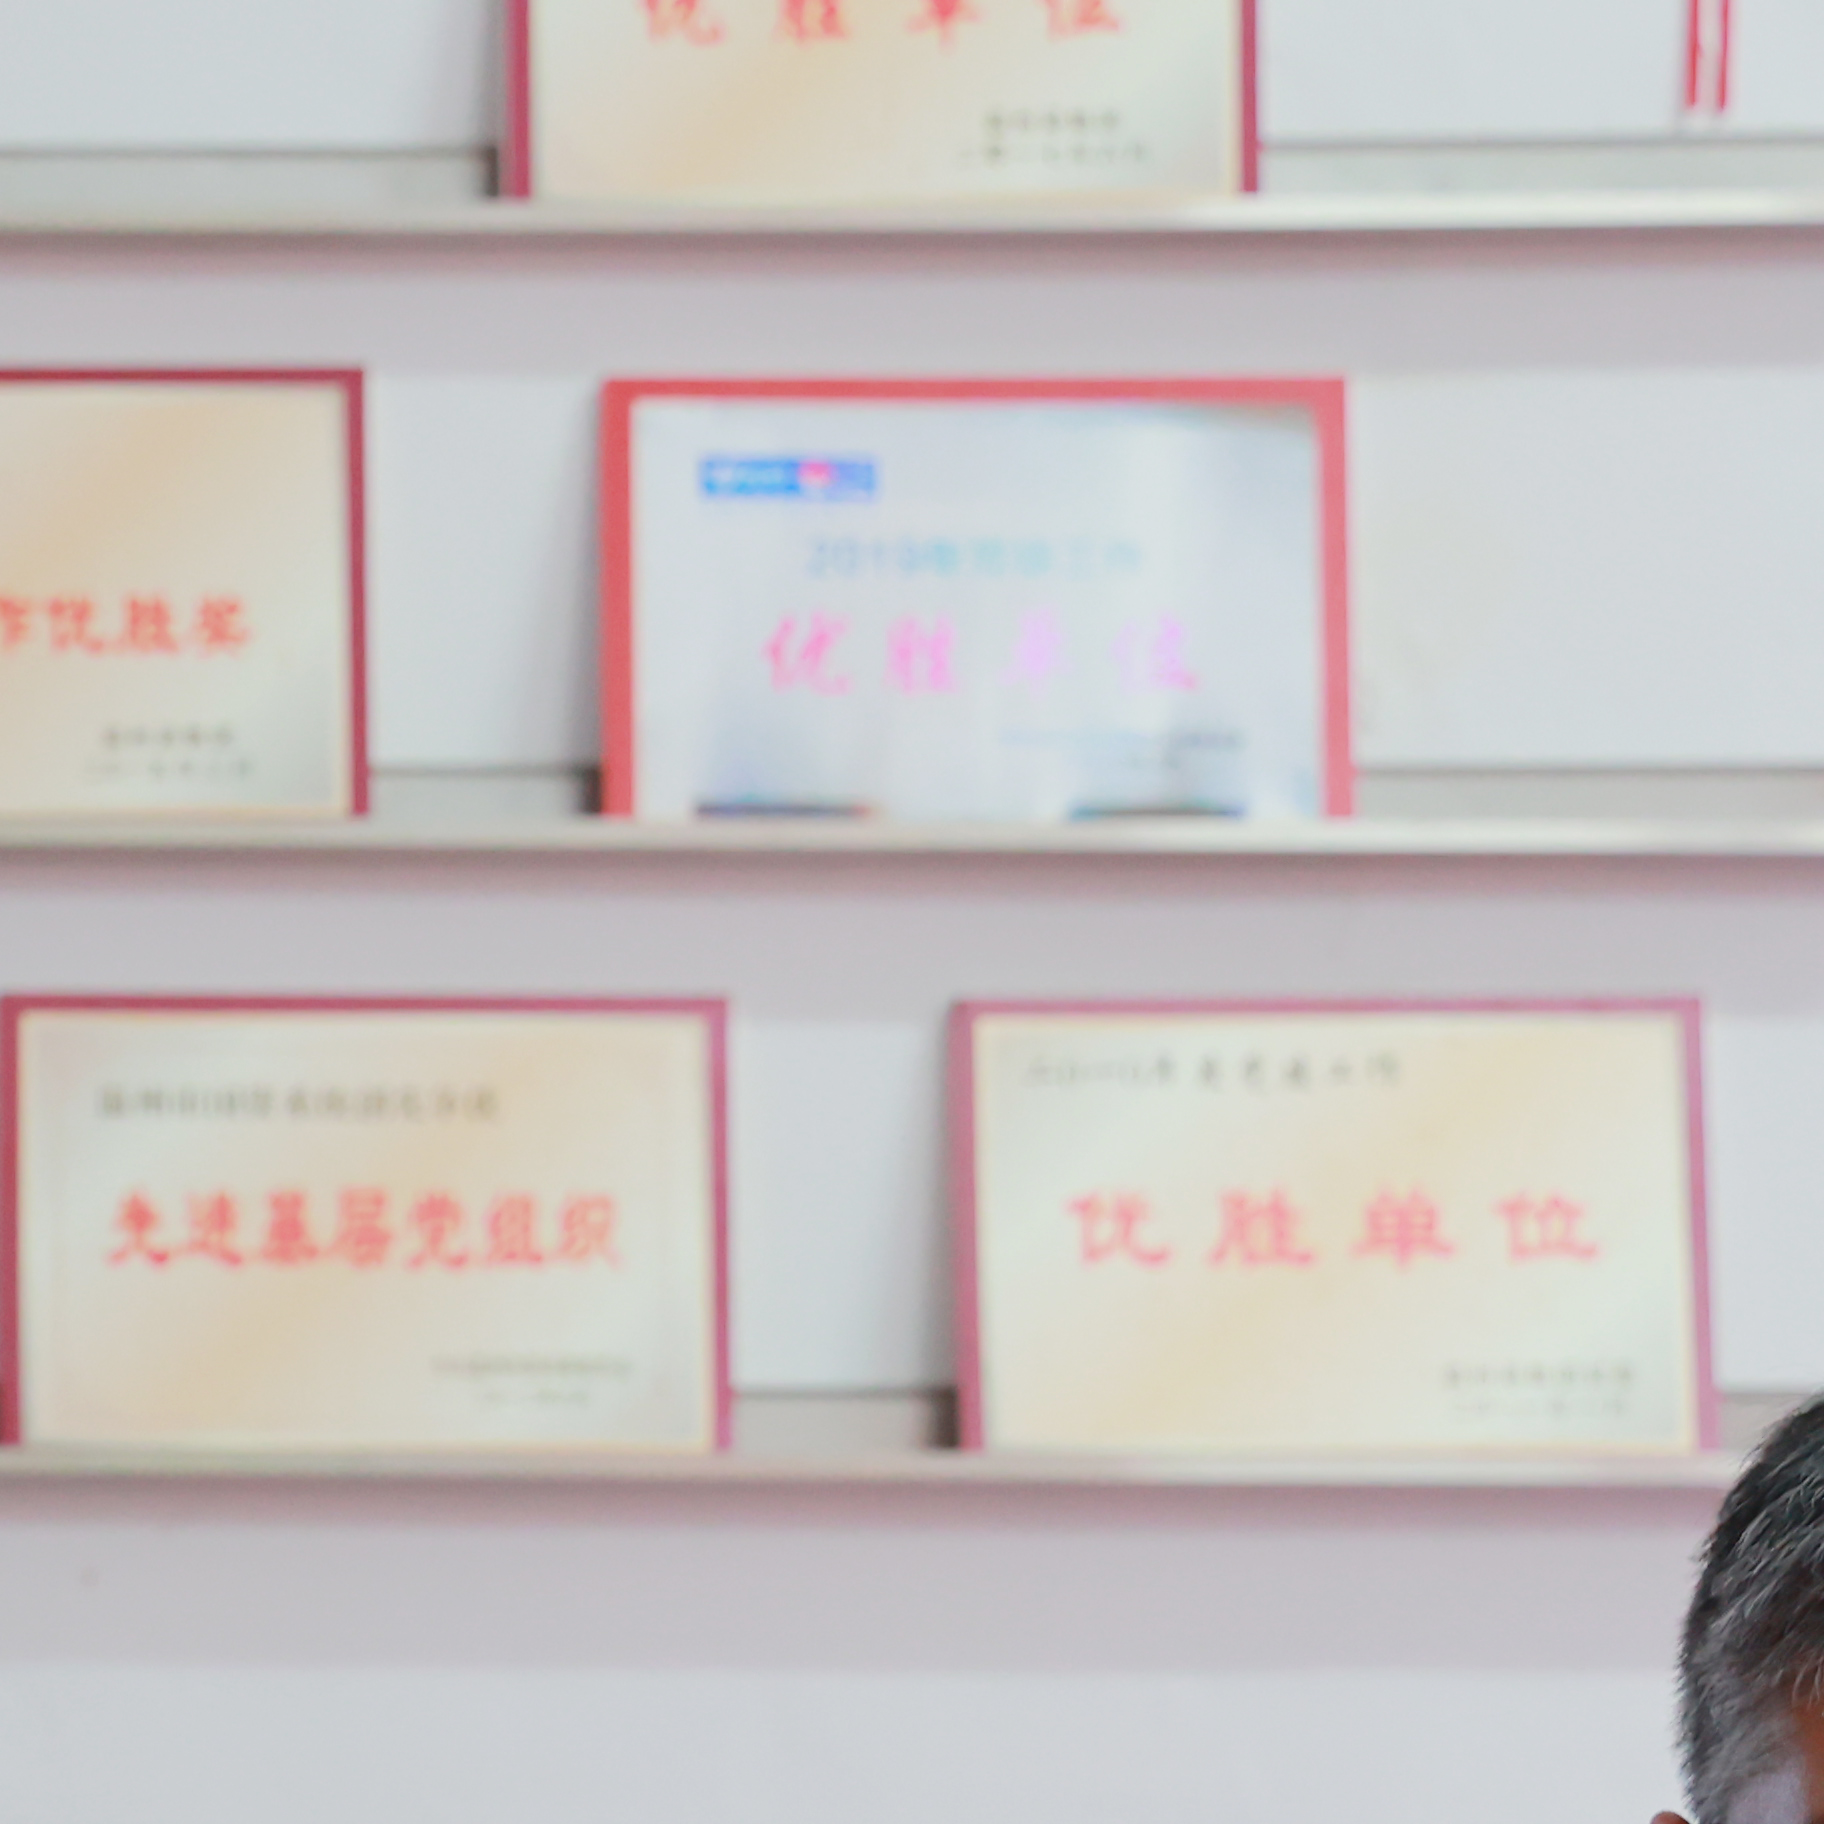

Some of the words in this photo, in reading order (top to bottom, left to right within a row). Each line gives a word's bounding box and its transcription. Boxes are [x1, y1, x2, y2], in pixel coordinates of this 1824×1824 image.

[759, 609, 1198, 697] 优胜单位
[105, 1185, 625, 1272] 先进基层党组织
[1064, 1185, 1602, 1268] 优胜单位
